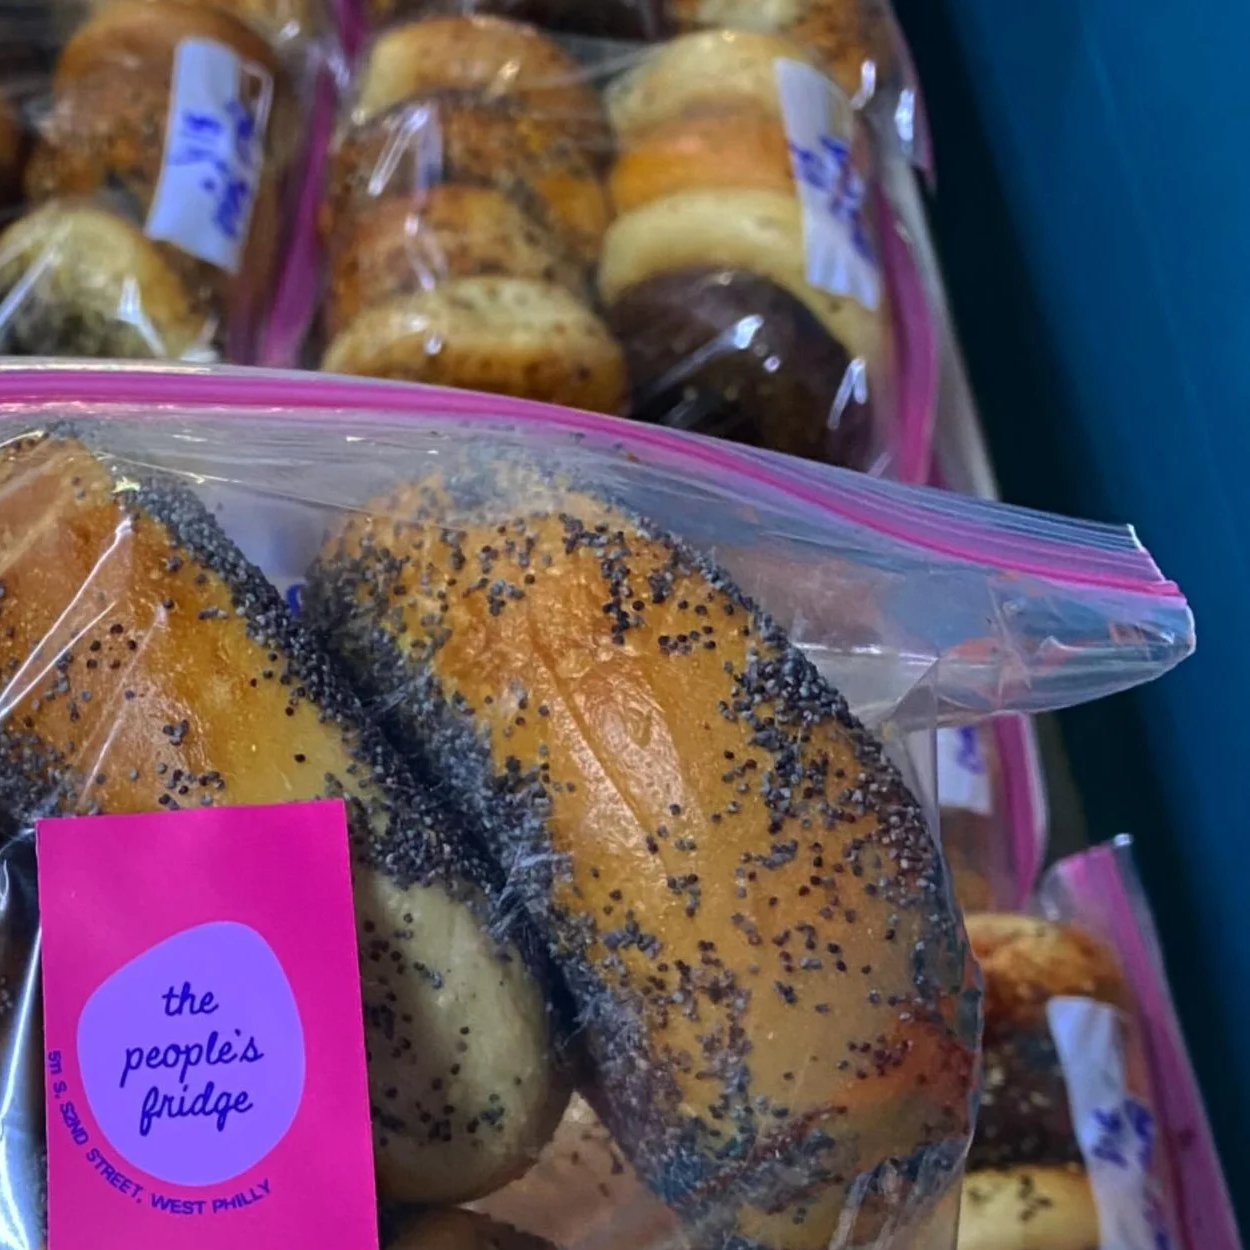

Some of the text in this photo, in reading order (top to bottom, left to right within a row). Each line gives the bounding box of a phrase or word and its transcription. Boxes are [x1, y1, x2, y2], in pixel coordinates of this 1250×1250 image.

[161, 981, 220, 1017] the
[119, 1028, 265, 1089] people's
[139, 1081, 254, 1137] fridge
[150, 1193, 207, 1216] WEST
[212, 1178, 272, 1214] PHILLY
